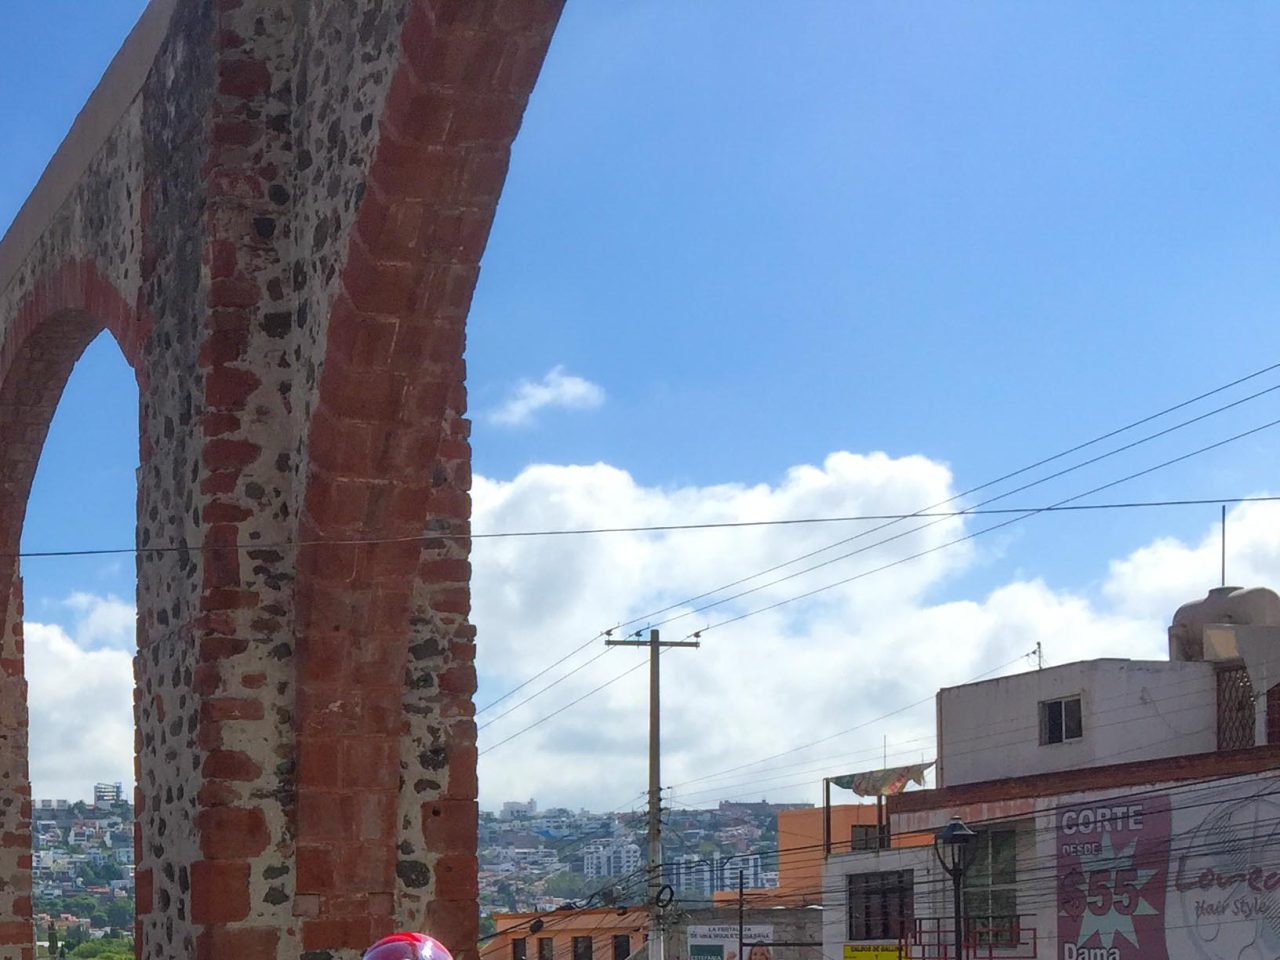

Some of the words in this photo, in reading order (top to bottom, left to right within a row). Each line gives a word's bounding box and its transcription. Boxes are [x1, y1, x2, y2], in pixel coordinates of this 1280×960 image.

[1062, 805, 1144, 834] CORTE
[1059, 868, 1141, 922] $55
[1232, 895, 1268, 920] Style
